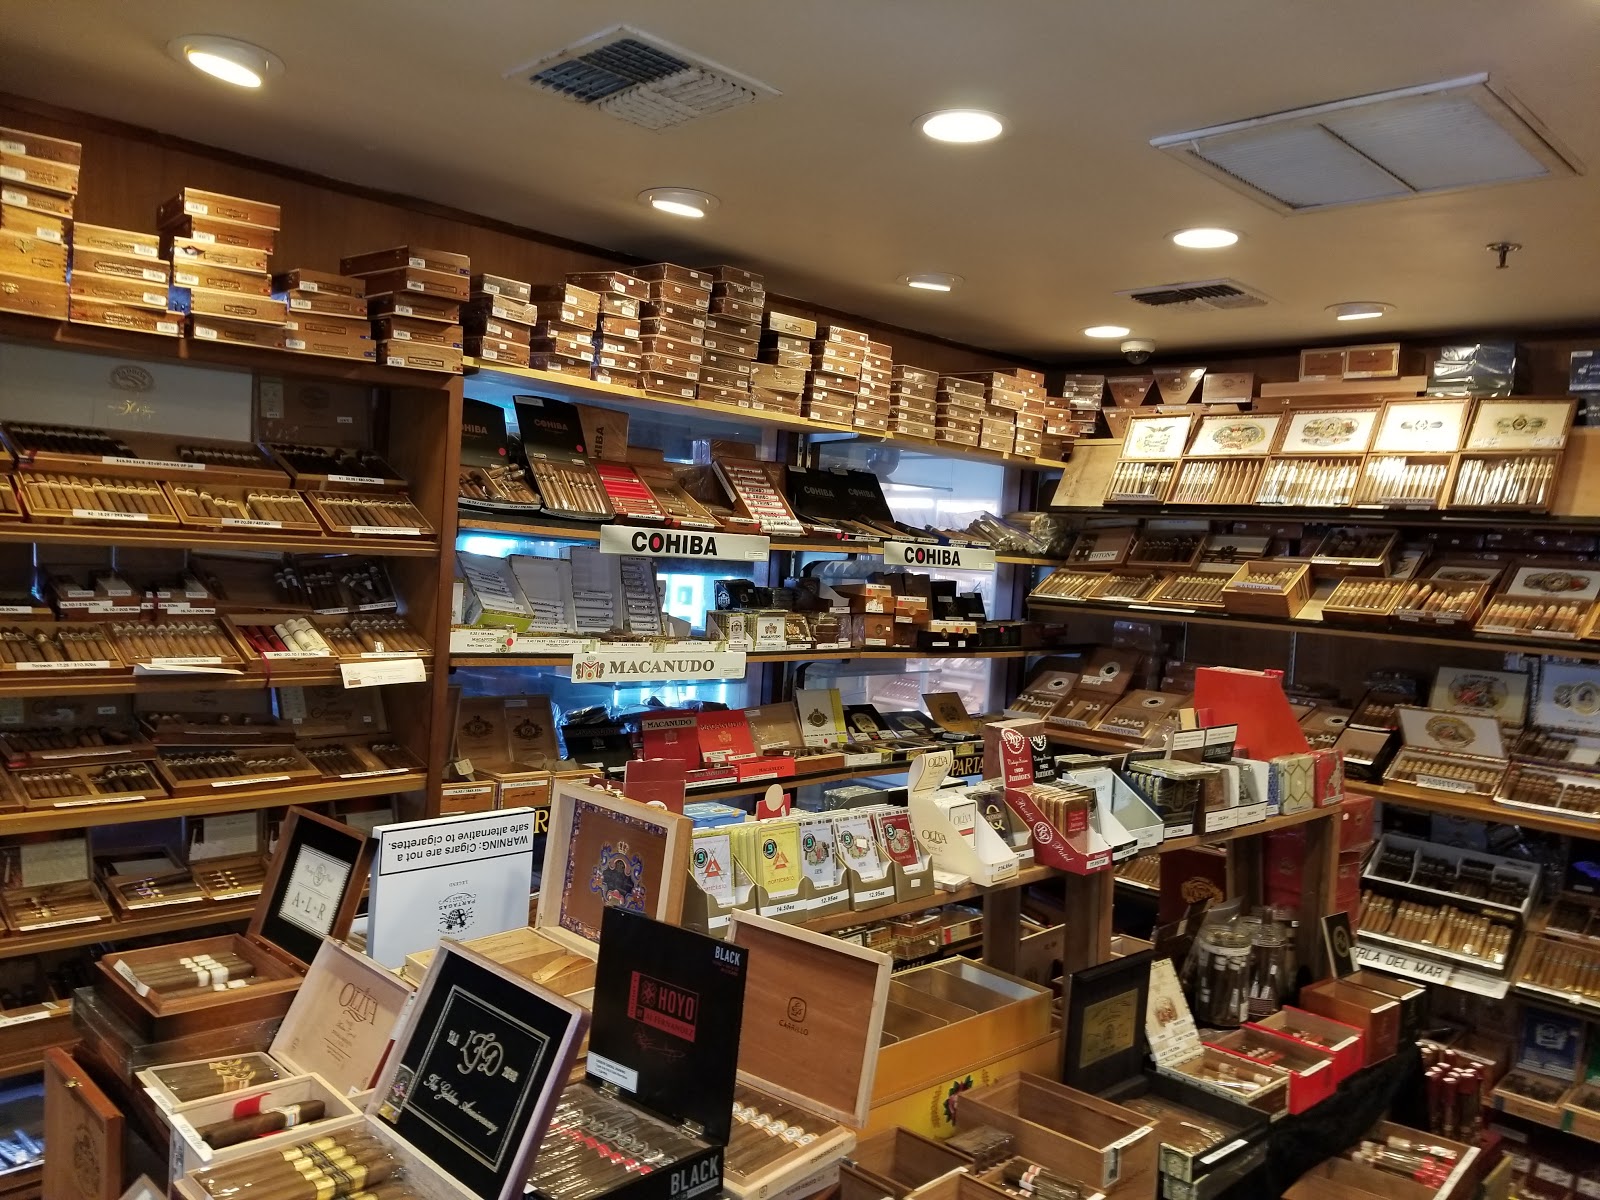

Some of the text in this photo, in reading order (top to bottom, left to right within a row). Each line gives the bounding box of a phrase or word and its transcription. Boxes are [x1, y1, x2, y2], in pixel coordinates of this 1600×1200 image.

[533, 418, 569, 431] COHIBA
[803, 485, 835, 498] COHIBA
[848, 487, 876, 499] COHIBA
[631, 531, 718, 556] COHIBA
[904, 546, 961, 567] COHIBA
[608, 659, 715, 675] MACANUDO
[647, 718, 693, 729] MACANUDO
[700, 721, 746, 732] MACANUDO
[758, 764, 785, 773] MACANUDO
[928, 755, 949, 768] OLIVA
[1007, 772, 1031, 783] Juniors
[1034, 768, 1055, 779] Juniors
[953, 813, 973, 826] OLIVA
[388, 823, 529, 850] safe alternative to cigarettes.
[922, 829, 948, 845] OLIVA
[397, 835, 528, 862] WARNING: Cigars are not a
[438, 899, 476, 911] PARTAGAS
[714, 945, 741, 967] BLACK
[1386, 956, 1407, 969] DEL
[1413, 963, 1445, 978] MAR
[338, 982, 379, 1026] OLIVA
[658, 986, 695, 1021] HOYO
[778, 1019, 810, 1036] CARRILLO
[670, 1155, 720, 1197] BLACK
